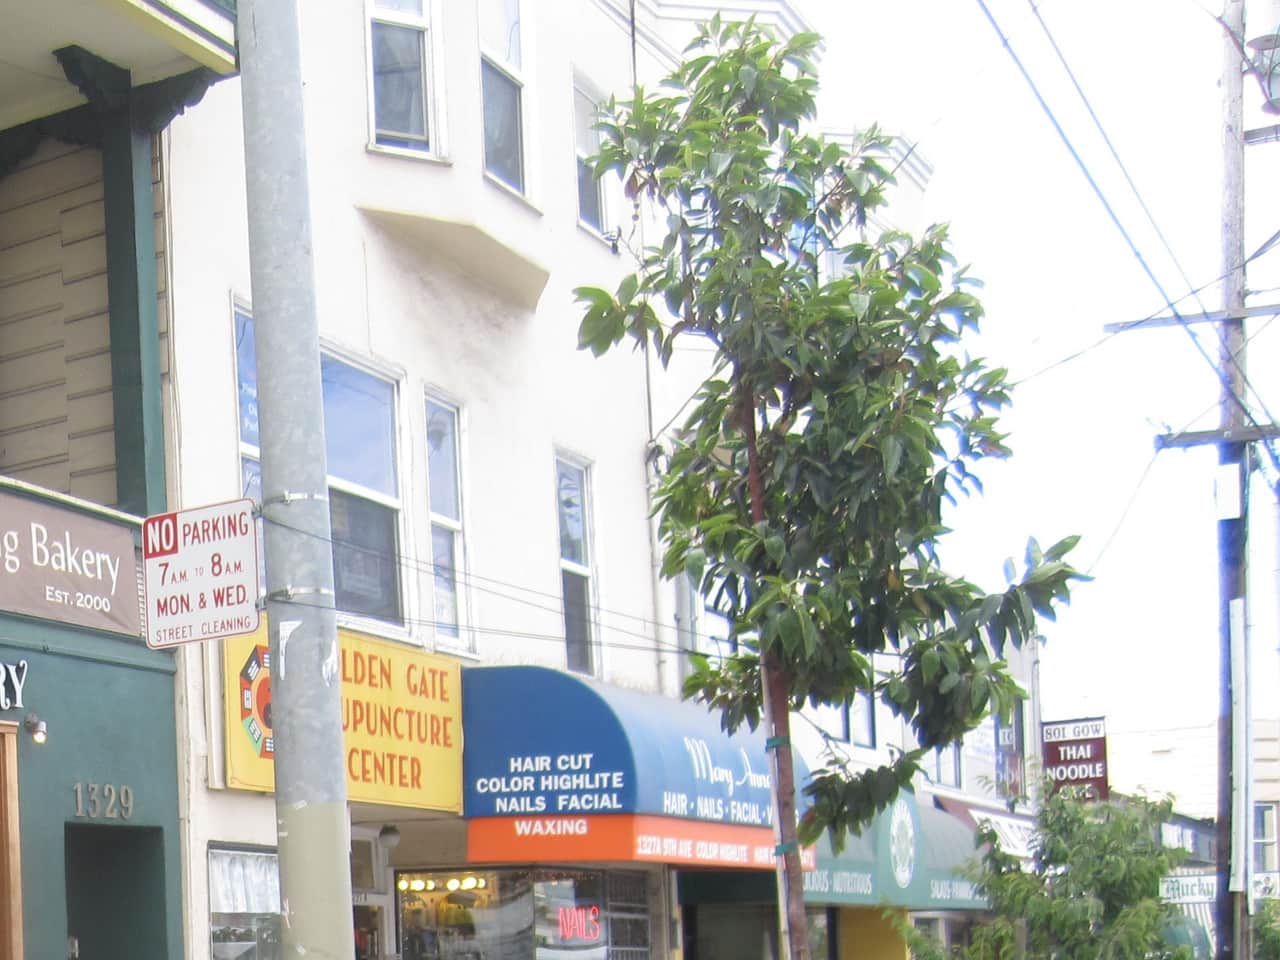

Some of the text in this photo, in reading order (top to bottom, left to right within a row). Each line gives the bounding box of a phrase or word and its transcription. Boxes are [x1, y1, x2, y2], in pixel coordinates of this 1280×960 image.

[147, 512, 248, 554] NO PARKING
[30, 521, 121, 596] Bakery
[195, 567, 204, 577] TO
[45, 585, 111, 613] EST. 2000
[156, 584, 249, 617] MON. & WED.
[156, 615, 251, 642] STREET CLEANING
[341, 648, 449, 702] LDEN GATE
[341, 697, 453, 748] UPUNCTURE
[510, 753, 593, 773] HAIR CUT
[1058, 745, 1091, 760] THAI
[348, 747, 422, 789] CENTER
[476, 772, 624, 793] COLOR HIGHLITE
[1046, 763, 1103, 780] NOODLE
[73, 782, 134, 818] 1329
[496, 793, 623, 812] NAILS FACIAL
[663, 792, 688, 815] HAIR
[697, 796, 724, 819] NAILS
[731, 801, 761, 824] FACIAL
[514, 819, 588, 836] WAXING
[559, 905, 601, 940] NAILS
